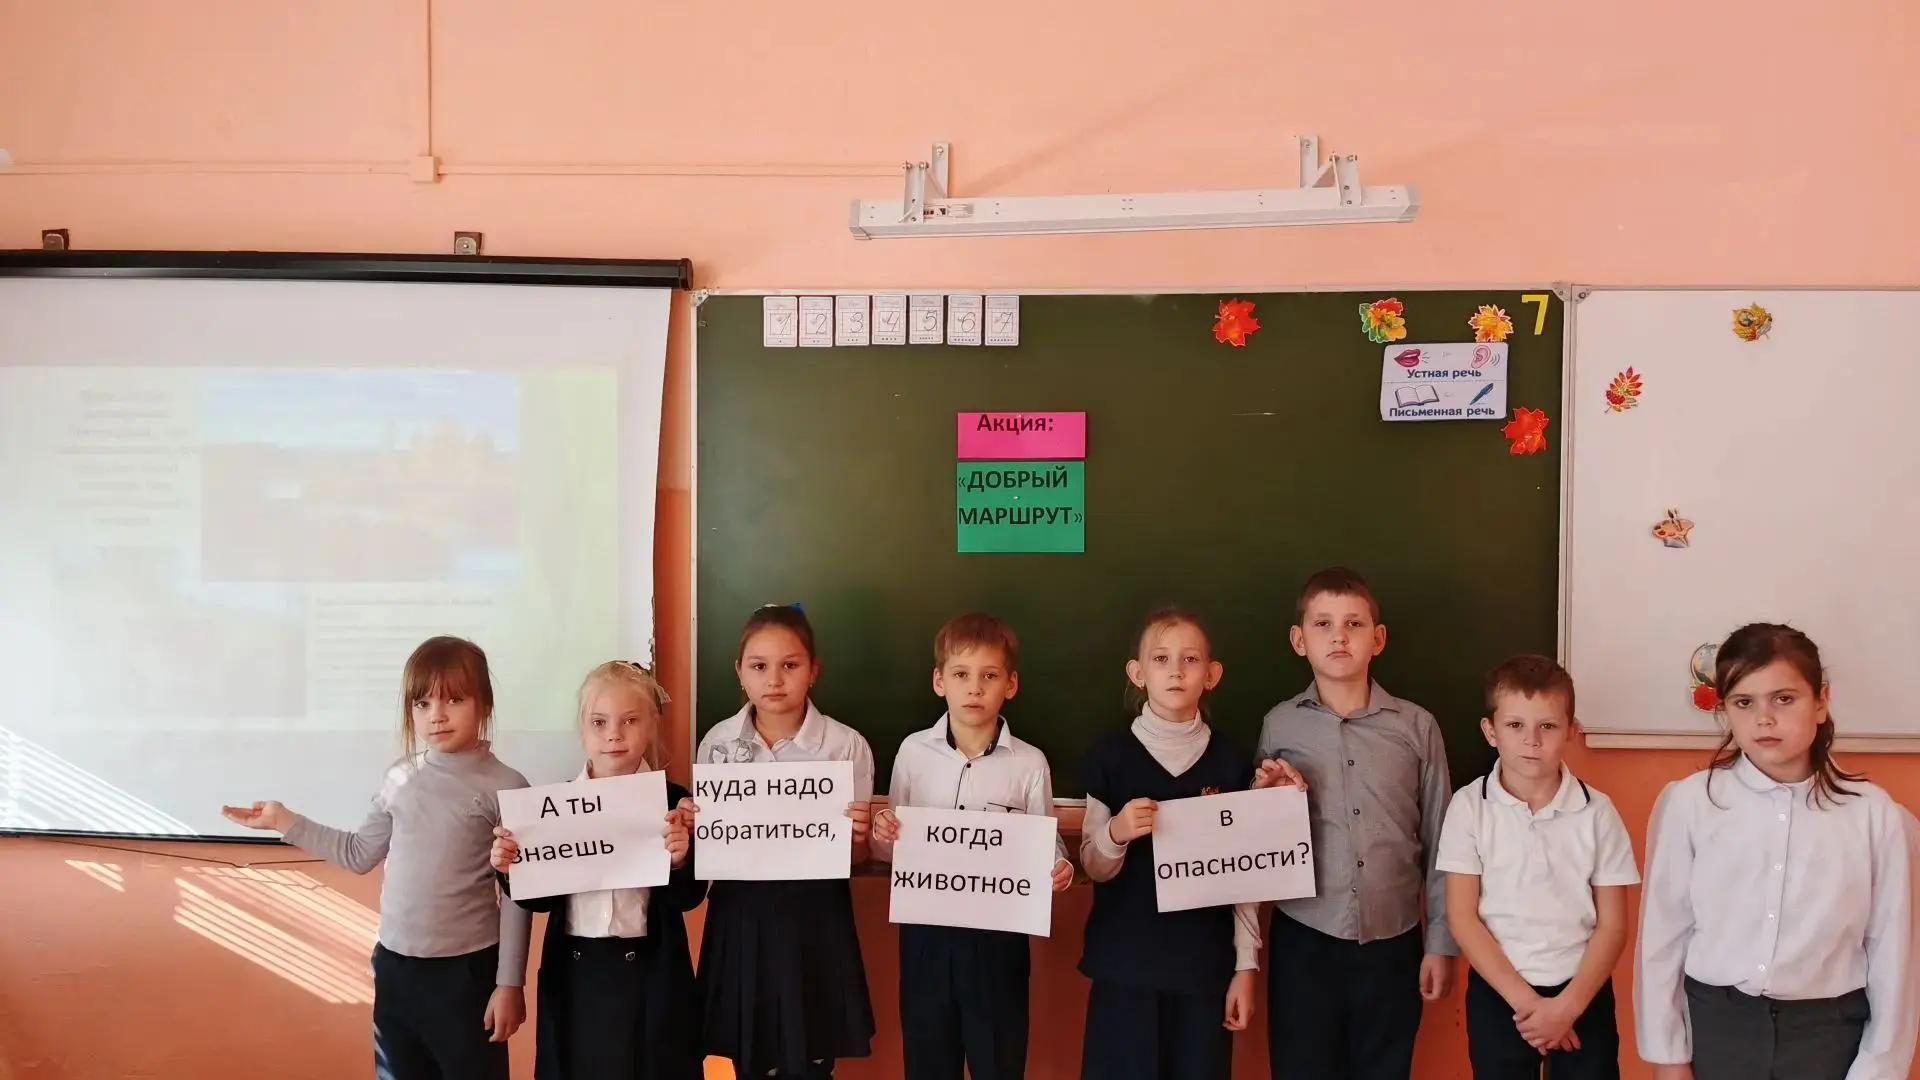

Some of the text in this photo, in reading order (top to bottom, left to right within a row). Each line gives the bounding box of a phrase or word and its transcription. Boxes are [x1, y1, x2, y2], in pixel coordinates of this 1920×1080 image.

[815, 312, 827, 335] 2
[850, 311, 864, 334] 3
[887, 311, 900, 333] 4
[924, 309, 938, 332] 5
[961, 311, 976, 333] 6
[1000, 312, 1013, 334] 7
[1521, 294, 1549, 335] 7
[1407, 368, 1482, 380] Устная речь
[1389, 406, 1496, 418] Письменная речь
[977, 413, 1054, 435] Акция:
[958, 465, 1068, 493] «ДОБРЫЙ
[958, 506, 1083, 525] МАРШРУТ»
[696, 776, 834, 802] куда надо
[540, 795, 602, 819] А ты
[696, 819, 837, 845] обратиться,
[926, 825, 1003, 851] когда
[1157, 841, 1310, 880] опасности?
[893, 870, 1032, 896] животное
